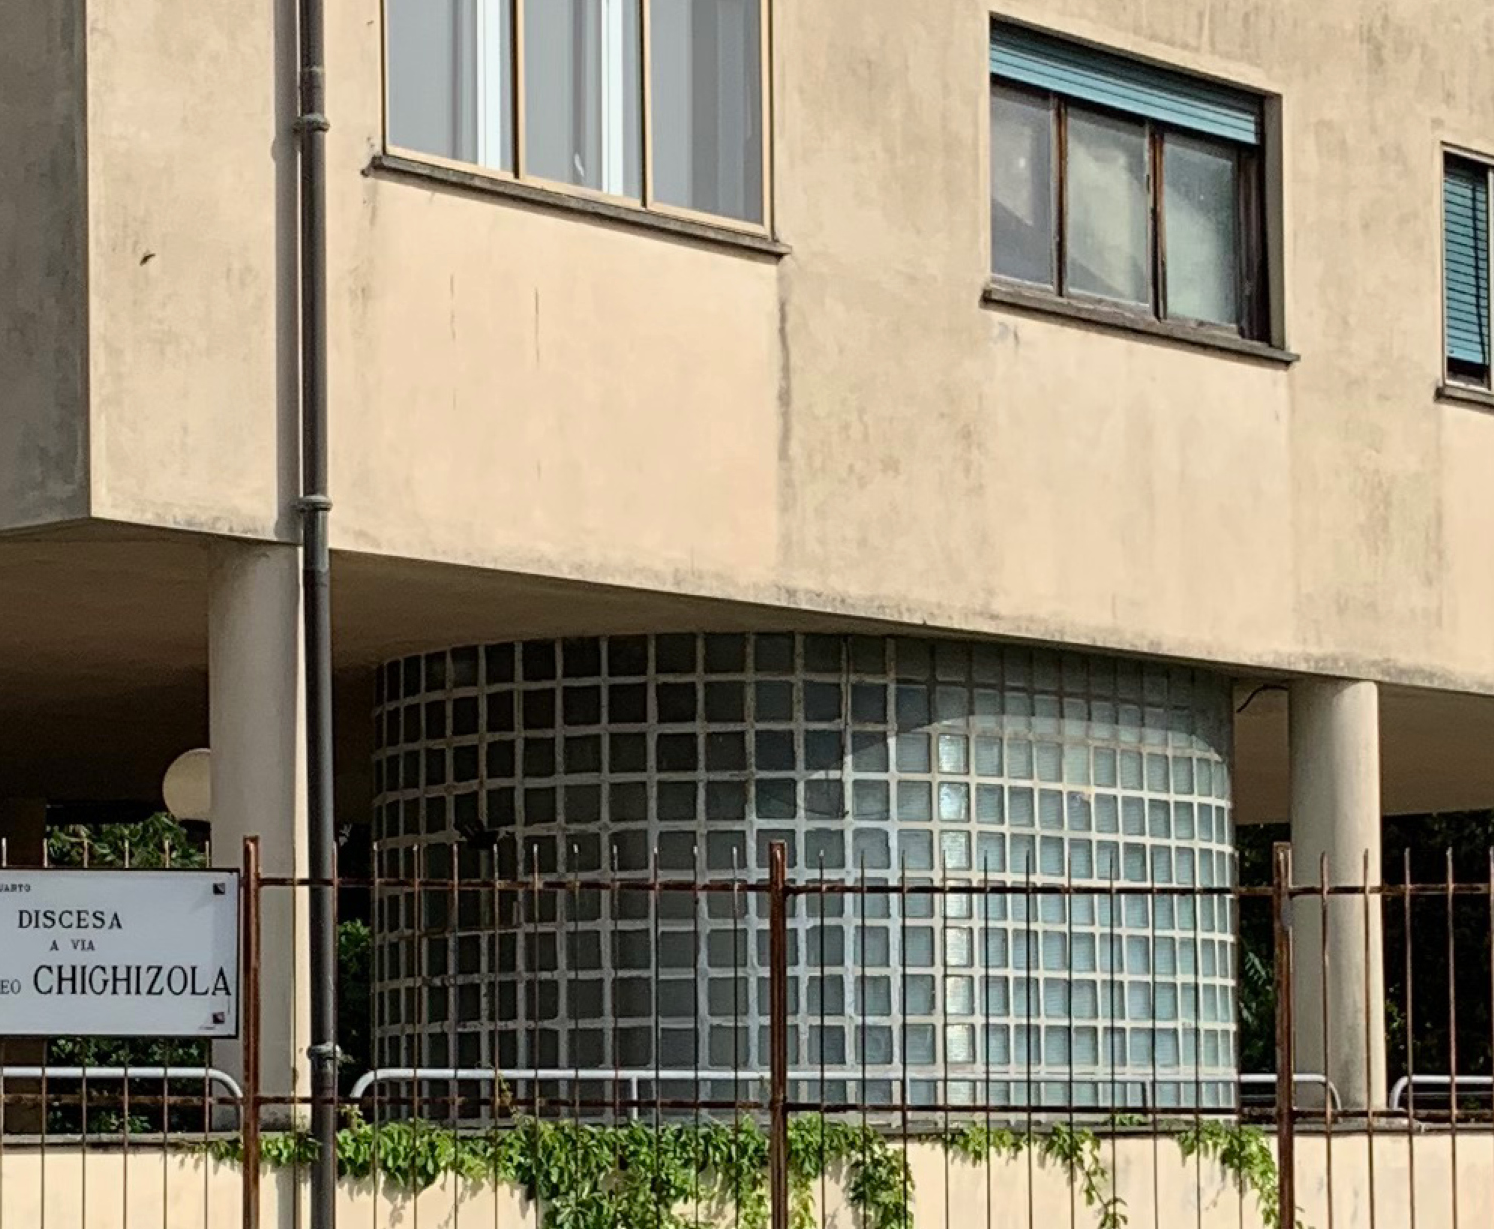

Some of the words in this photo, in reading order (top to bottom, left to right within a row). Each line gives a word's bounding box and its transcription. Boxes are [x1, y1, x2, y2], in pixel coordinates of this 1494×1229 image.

[17, 909, 123, 930] DISCESA
[49, 939, 60, 952] A
[70, 939, 96, 952] VIA
[32, 964, 232, 996] CHIGHIZOLA
